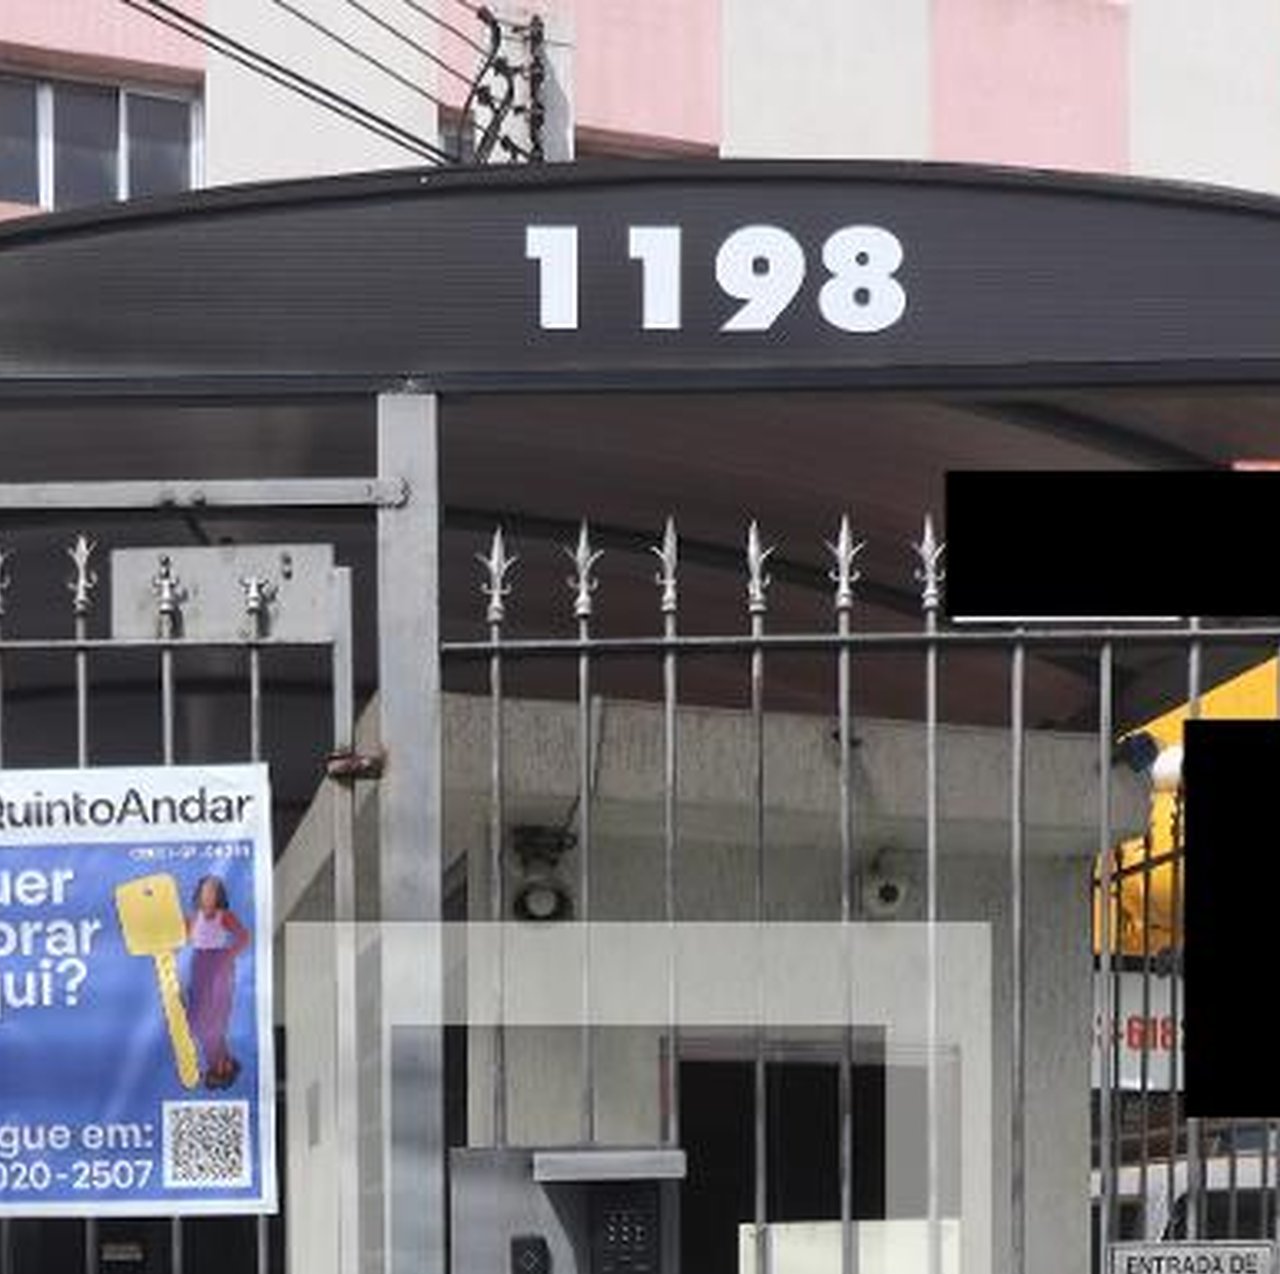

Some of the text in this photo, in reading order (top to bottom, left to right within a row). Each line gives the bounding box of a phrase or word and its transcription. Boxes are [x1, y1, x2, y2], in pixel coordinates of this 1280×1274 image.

[526, 225, 906, 332] 1198
[82, 1124, 154, 1150] em:
[1229, 1253, 1258, 1274] DE
